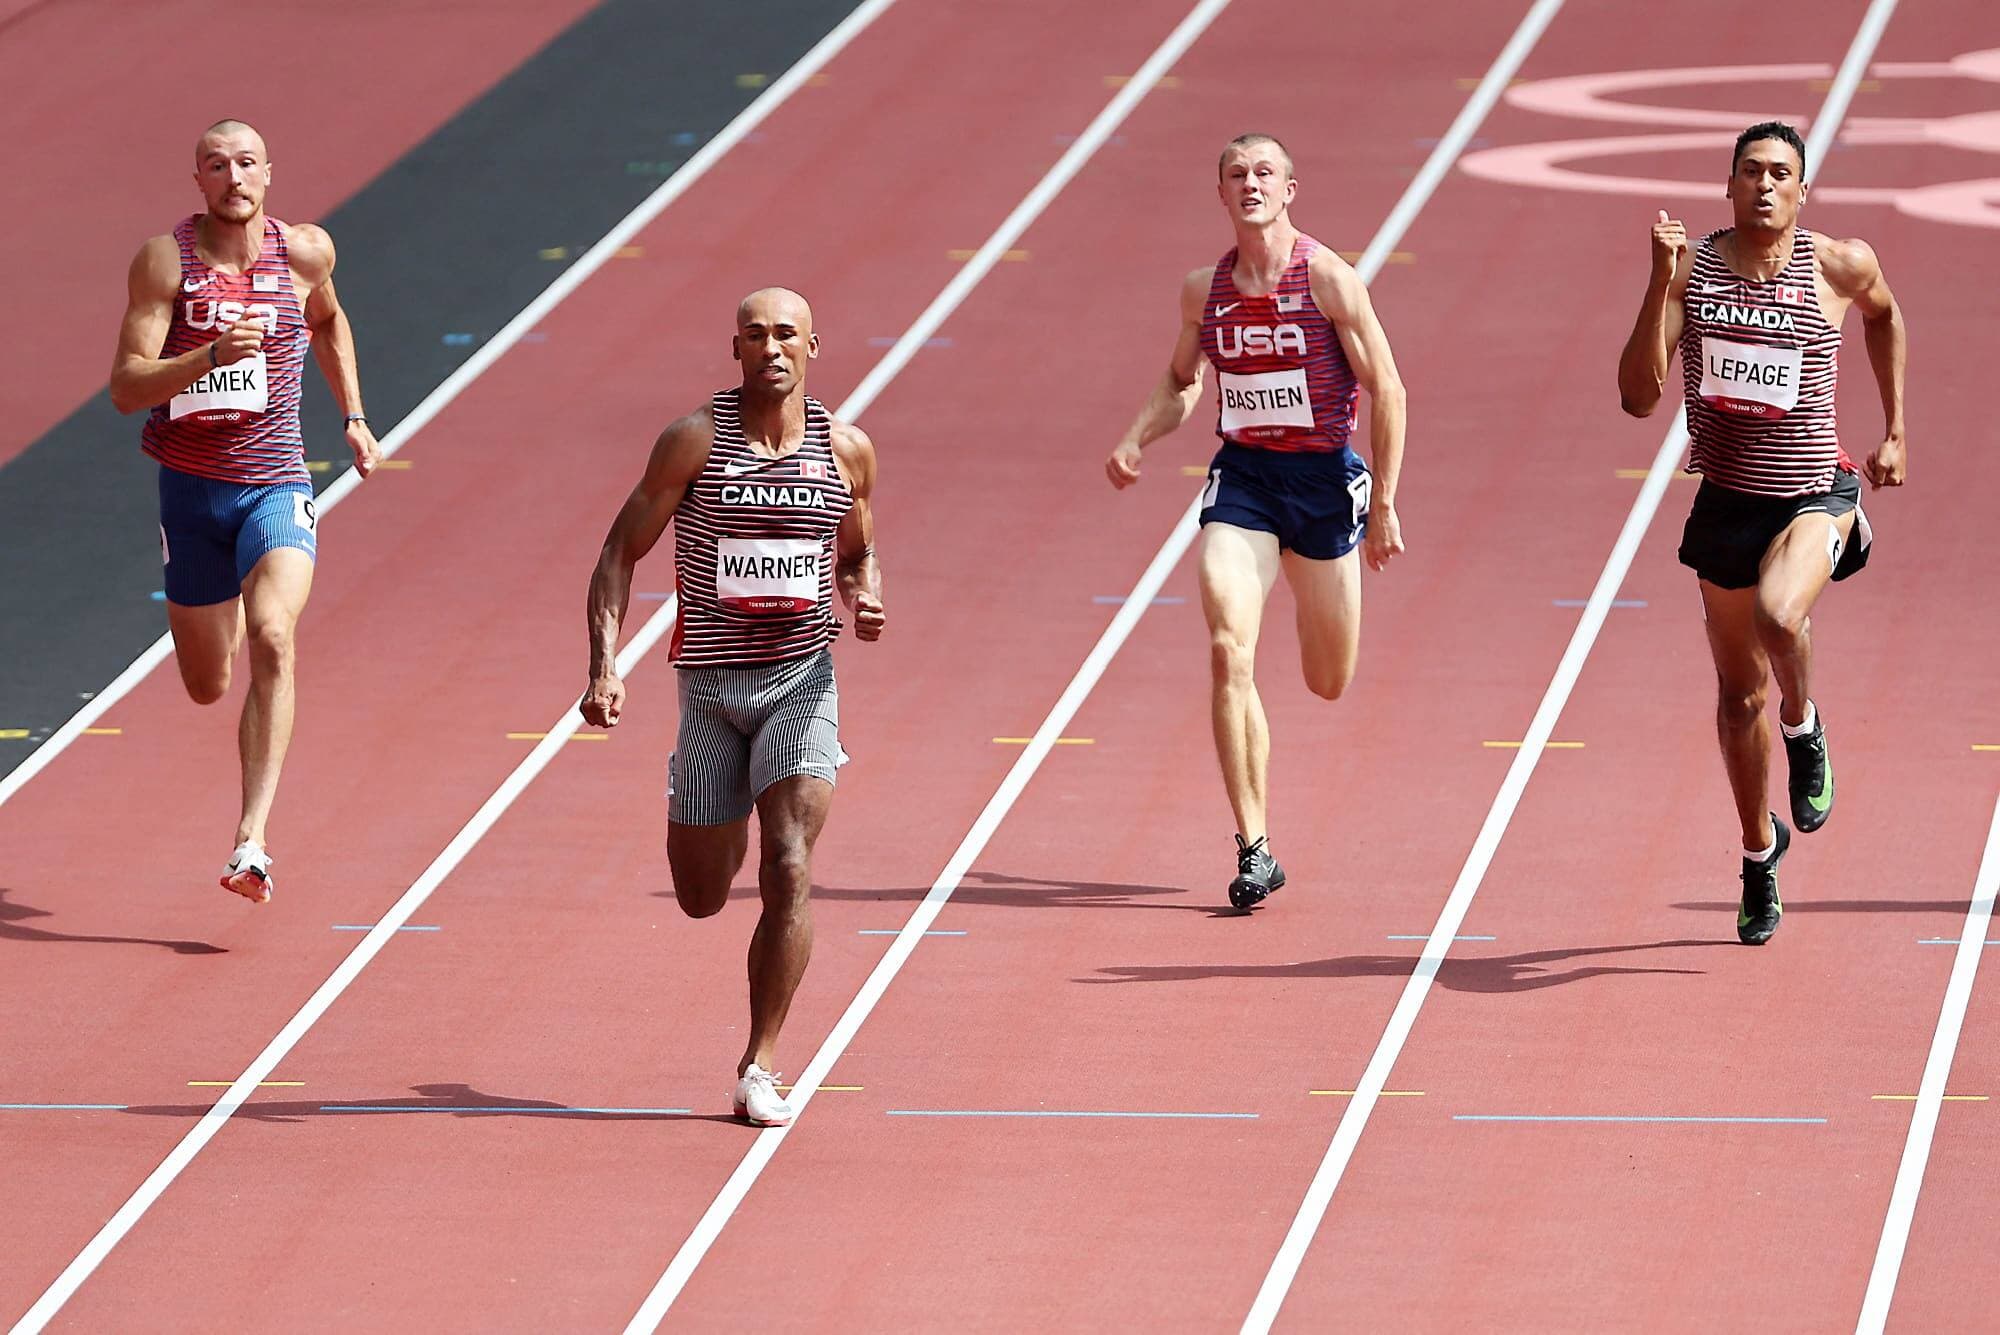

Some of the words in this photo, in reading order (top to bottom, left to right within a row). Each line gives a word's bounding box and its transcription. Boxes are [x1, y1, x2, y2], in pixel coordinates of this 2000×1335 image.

[185, 300, 278, 336] USA
[1700, 302, 1795, 331] CANADA
[1216, 323, 1307, 358] USA
[1710, 355, 1790, 387] LEPAGE
[1226, 385, 1303, 411] BASTIEN
[721, 485, 826, 508] CANADA
[723, 554, 815, 579] WARNER
